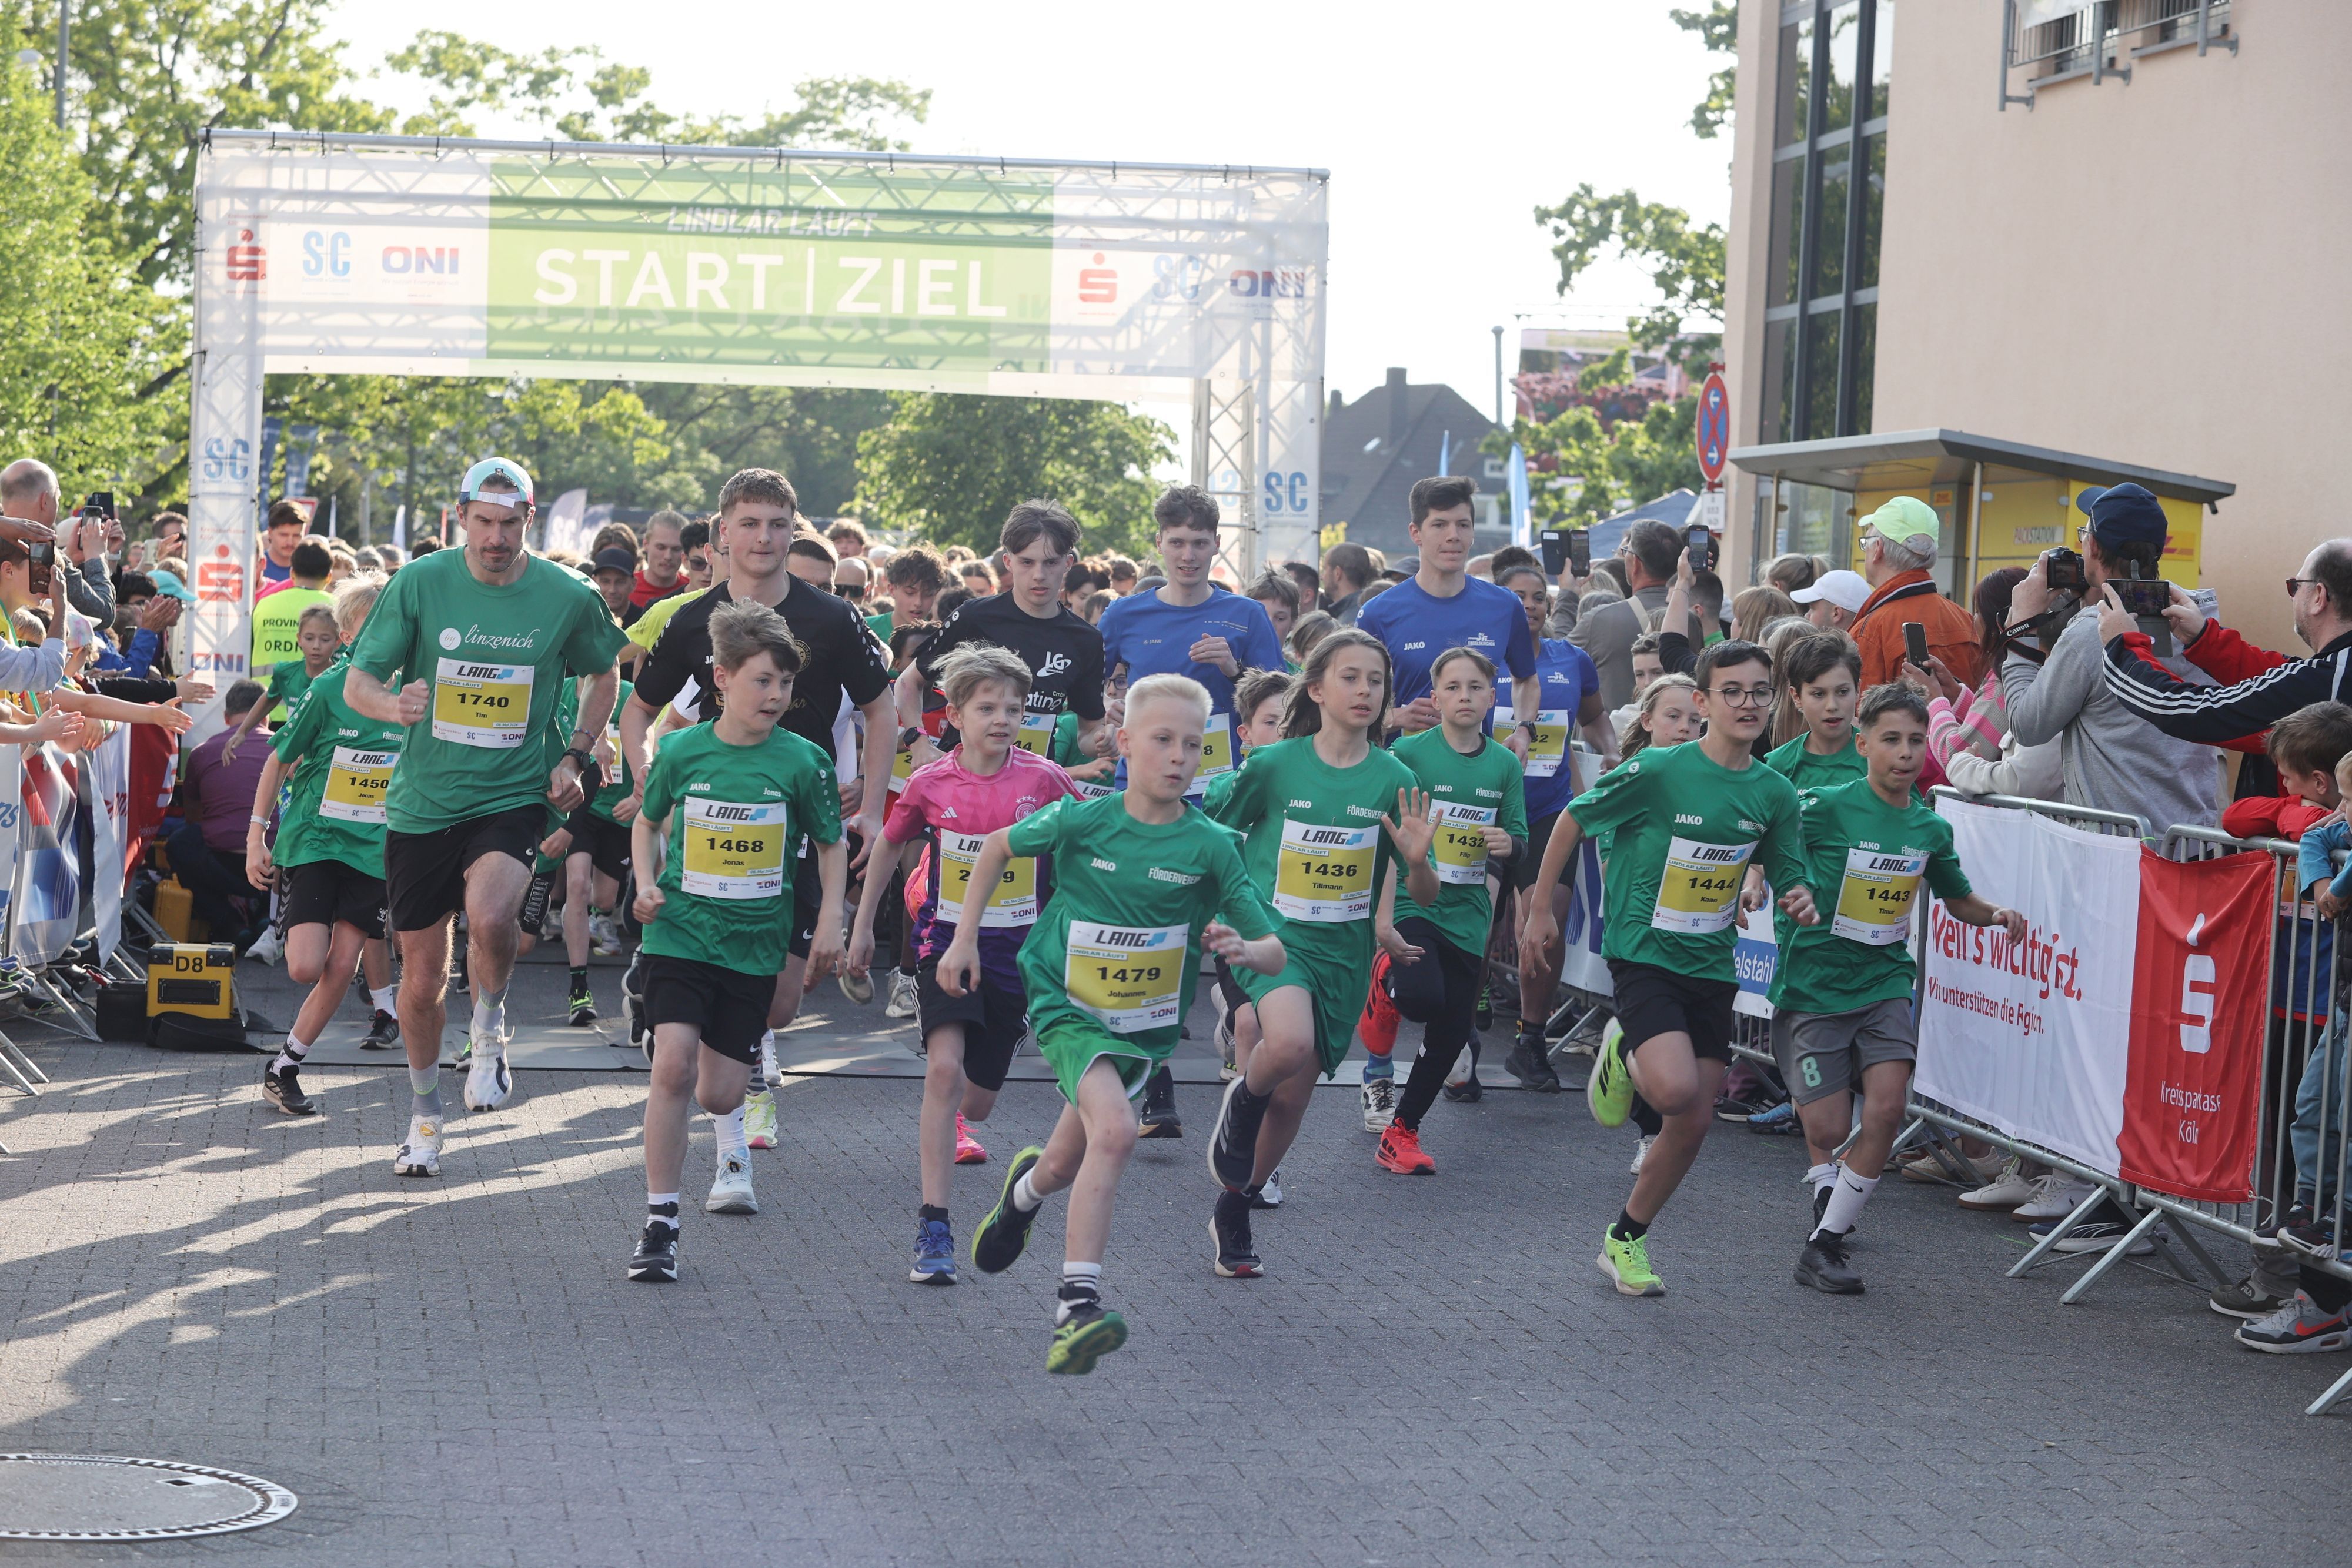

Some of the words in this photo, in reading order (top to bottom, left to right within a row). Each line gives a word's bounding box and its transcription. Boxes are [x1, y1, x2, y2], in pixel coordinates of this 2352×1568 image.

[667, 206, 781, 235] LINDLAR
[790, 205, 878, 238] LÄUFT
[303, 231, 350, 276] SC
[382, 246, 459, 274] ONI
[533, 249, 783, 311] START
[837, 258, 1007, 318] ZIEL
[1230, 270, 1305, 298] ONI
[1265, 472, 1307, 512] SC
[263, 618, 299, 628] PROVIN
[2006, 623, 2029, 636] Canon
[465, 624, 540, 648] linzenich
[265, 640, 302, 652] ORDN
[1404, 641, 1425, 650] JAKO
[191, 653, 243, 672] ONI
[1045, 651, 1064, 670] LG
[457, 665, 499, 679] LANG
[457, 693, 509, 708] 1740
[338, 728, 358, 737] JAKO
[467, 731, 475, 740] SC
[351, 754, 385, 764] LANG
[349, 777, 389, 788] 1450
[763, 787, 781, 797] Jonas
[1289, 799, 1312, 809] JAKO
[705, 804, 752, 820] LANG
[1448, 807, 1485, 821] LANG
[686, 820, 710, 829] LINDLAR
[1675, 814, 1703, 825] JAKO
[1301, 829, 1348, 844] LANG
[706, 837, 764, 852] 1468
[1282, 844, 1306, 852] LINDLAR
[1859, 841, 1880, 851] JAKO
[941, 852, 963, 861] LINDLAR
[1691, 847, 1735, 861] LANG
[1090, 857, 1116, 871] JAKO
[1301, 862, 1358, 877] 1436
[1668, 860, 1695, 870] LINDLAR
[1869, 857, 1909, 872] LANG
[1846, 871, 1872, 880] LINDLAR
[719, 882, 728, 891] SC
[764, 880, 780, 888] ONI
[1689, 877, 1735, 891] 1444
[1866, 888, 1910, 902] 1443
[1018, 908, 1034, 917] ONI
[1311, 906, 1321, 915] SC
[1354, 902, 1368, 911] ONI
[1692, 918, 1699, 927] SC
[1095, 930, 1150, 947] LANG
[1871, 930, 1879, 939] SC
[1070, 948, 1100, 957] LINDLAR
[1102, 951, 1125, 959] LÄUFT
[176, 955, 203, 972] D8
[1733, 951, 1775, 984] elstahl
[1097, 967, 1161, 982] 1479
[1943, 986, 1998, 1019] unterstützen
[2001, 998, 2014, 1024] die
[1158, 1007, 1176, 1018] ONI
[1110, 1017, 1120, 1026] SC
[1802, 1056, 1822, 1088] 8
[2179, 1119, 2199, 1145] Köln
[2240, 1285, 2253, 1297] FILA
